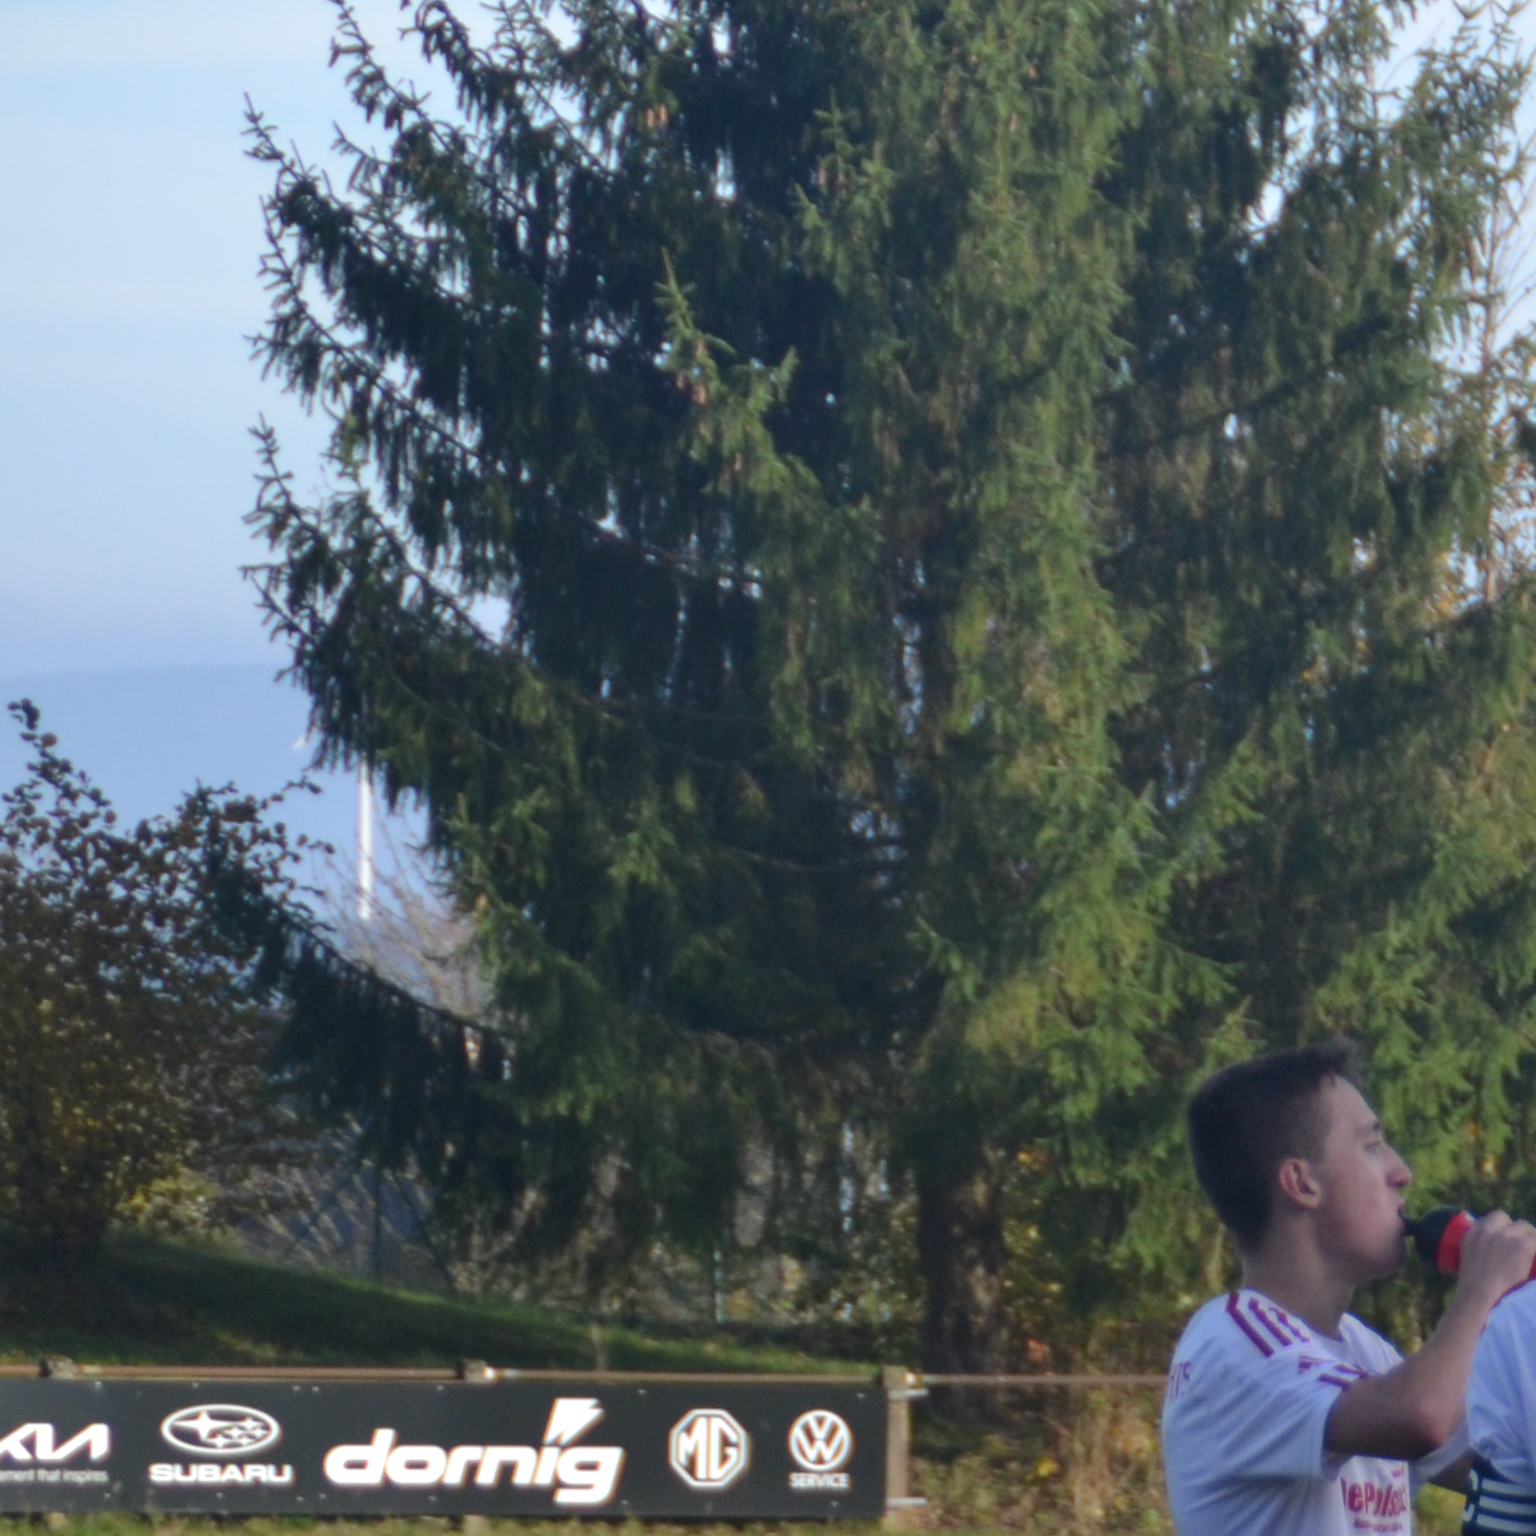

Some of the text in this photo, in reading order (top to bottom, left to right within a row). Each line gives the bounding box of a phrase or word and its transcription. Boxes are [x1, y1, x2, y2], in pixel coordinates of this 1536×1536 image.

[323, 1398, 623, 1503] dornig
[676, 1413, 741, 1484] MG
[0, 1469, 35, 1482] ement
[150, 1463, 293, 1483] SUBARU
[789, 1472, 850, 1489] SERVICE
